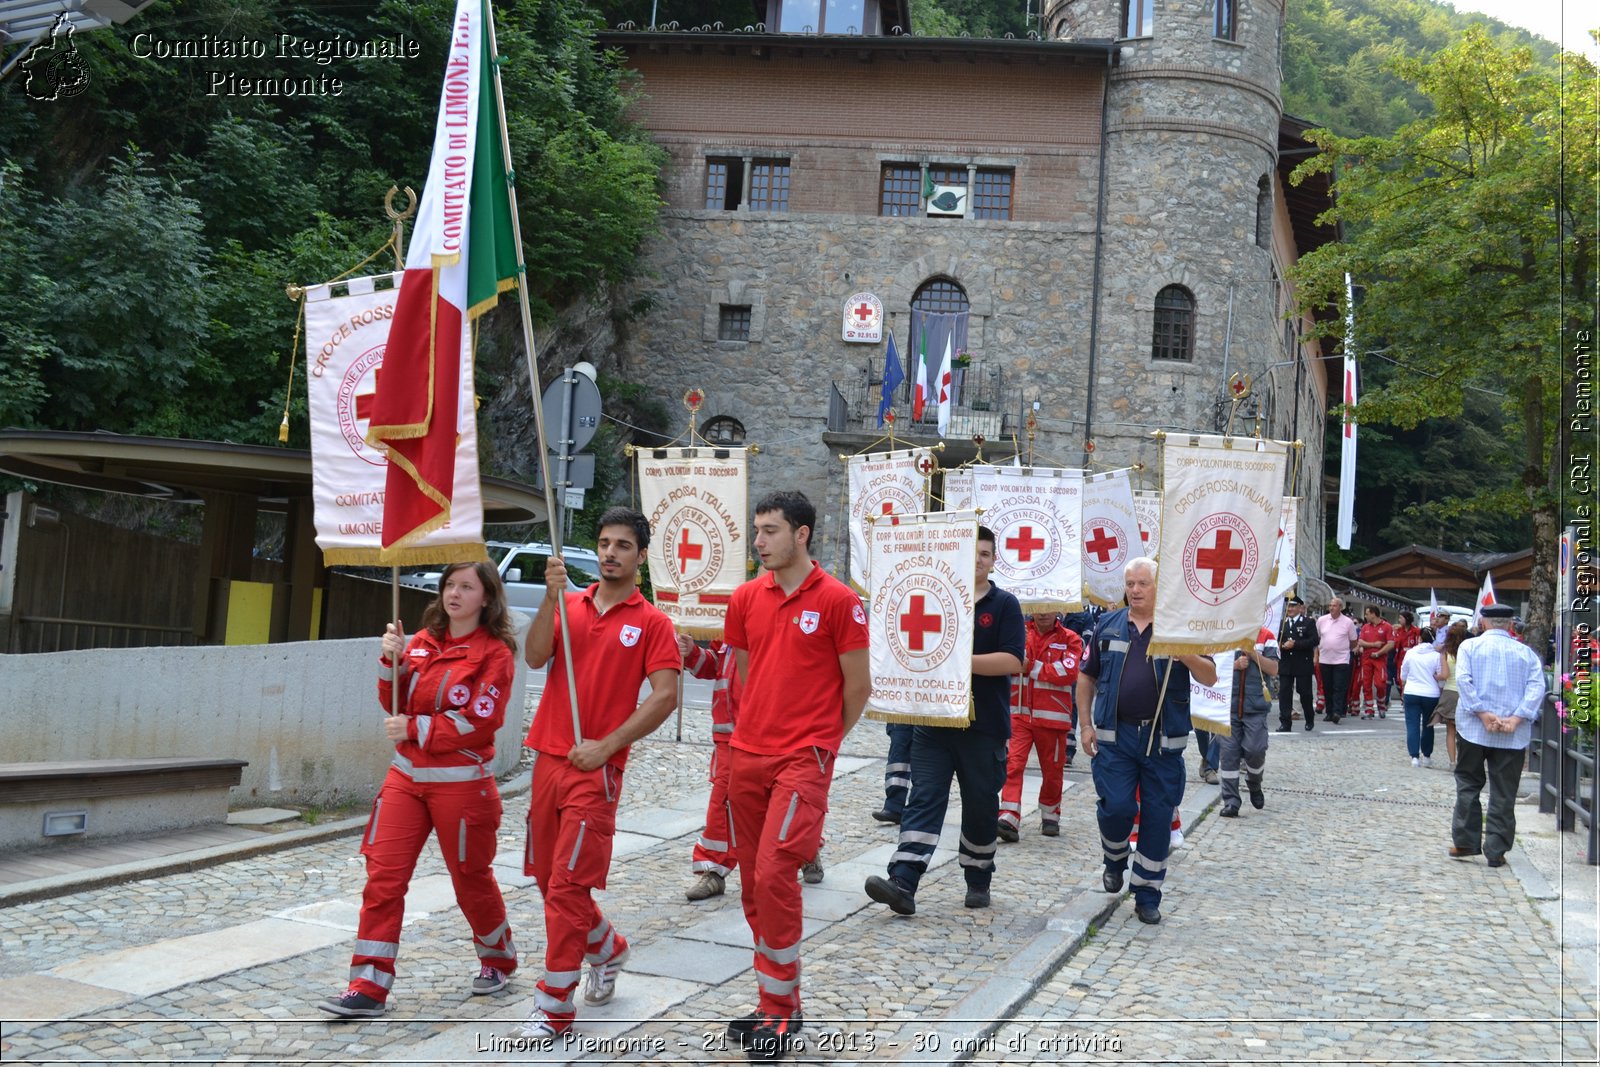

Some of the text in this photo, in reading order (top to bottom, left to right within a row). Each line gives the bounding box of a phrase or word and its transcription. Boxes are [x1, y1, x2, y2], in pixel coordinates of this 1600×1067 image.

[445, 54, 469, 128] LIMONE
[449, 133, 467, 150] DI
[443, 155, 467, 251] COMITATO
[312, 304, 394, 378] CROCE ROSS
[339, 348, 387, 452] CONVENZIONE DI GIN
[645, 467, 662, 477] CORPO
[694, 466, 706, 476] DEL
[709, 467, 738, 477] SOCCORSO
[1176, 458, 1276, 472] CORPO VOLONTARI DEL SOCCORSO
[852, 485, 869, 518] CROCE
[869, 473, 897, 490] ROSSA
[1000, 484, 1033, 494] VOLONTARI
[1035, 486, 1047, 494] DEL
[335, 491, 386, 507] COMITAT
[1083, 497, 1100, 508] OSSA
[1174, 479, 1274, 518] CROCE ROSSA ITALIANA
[649, 499, 670, 537] CROCE
[701, 490, 742, 543] ITALIANA
[673, 516, 681, 528] DI
[1001, 495, 1041, 509] ROSSA
[1043, 498, 1076, 541] ITALIANA
[1002, 517, 1010, 526] DI
[338, 522, 383, 535] LIMONE
[708, 527, 718, 540] 22
[876, 531, 891, 541] CORP
[928, 529, 940, 539] DEL
[928, 542, 932, 551] E
[1184, 531, 1202, 593] CONVENZIONE
[1200, 522, 1209, 532] DI
[1209, 515, 1240, 529] GINEVRA
[1240, 525, 1250, 537] 22
[1245, 536, 1257, 575] AGOSTO
[706, 542, 721, 577] AGOSTO
[873, 555, 973, 615] CROCE ROSSA ITALIANA
[1026, 587, 1037, 597] DI
[1042, 588, 1072, 598] ALBA
[685, 606, 727, 618] MONDO
[887, 576, 956, 667] CONVENZIONE DI GINEVRA 22 AGOSTO 1864
[874, 676, 965, 690] COMITATO LOCALE DI
[914, 691, 968, 705] DALMAZZO
[1203, 687, 1226, 704] TORRE
